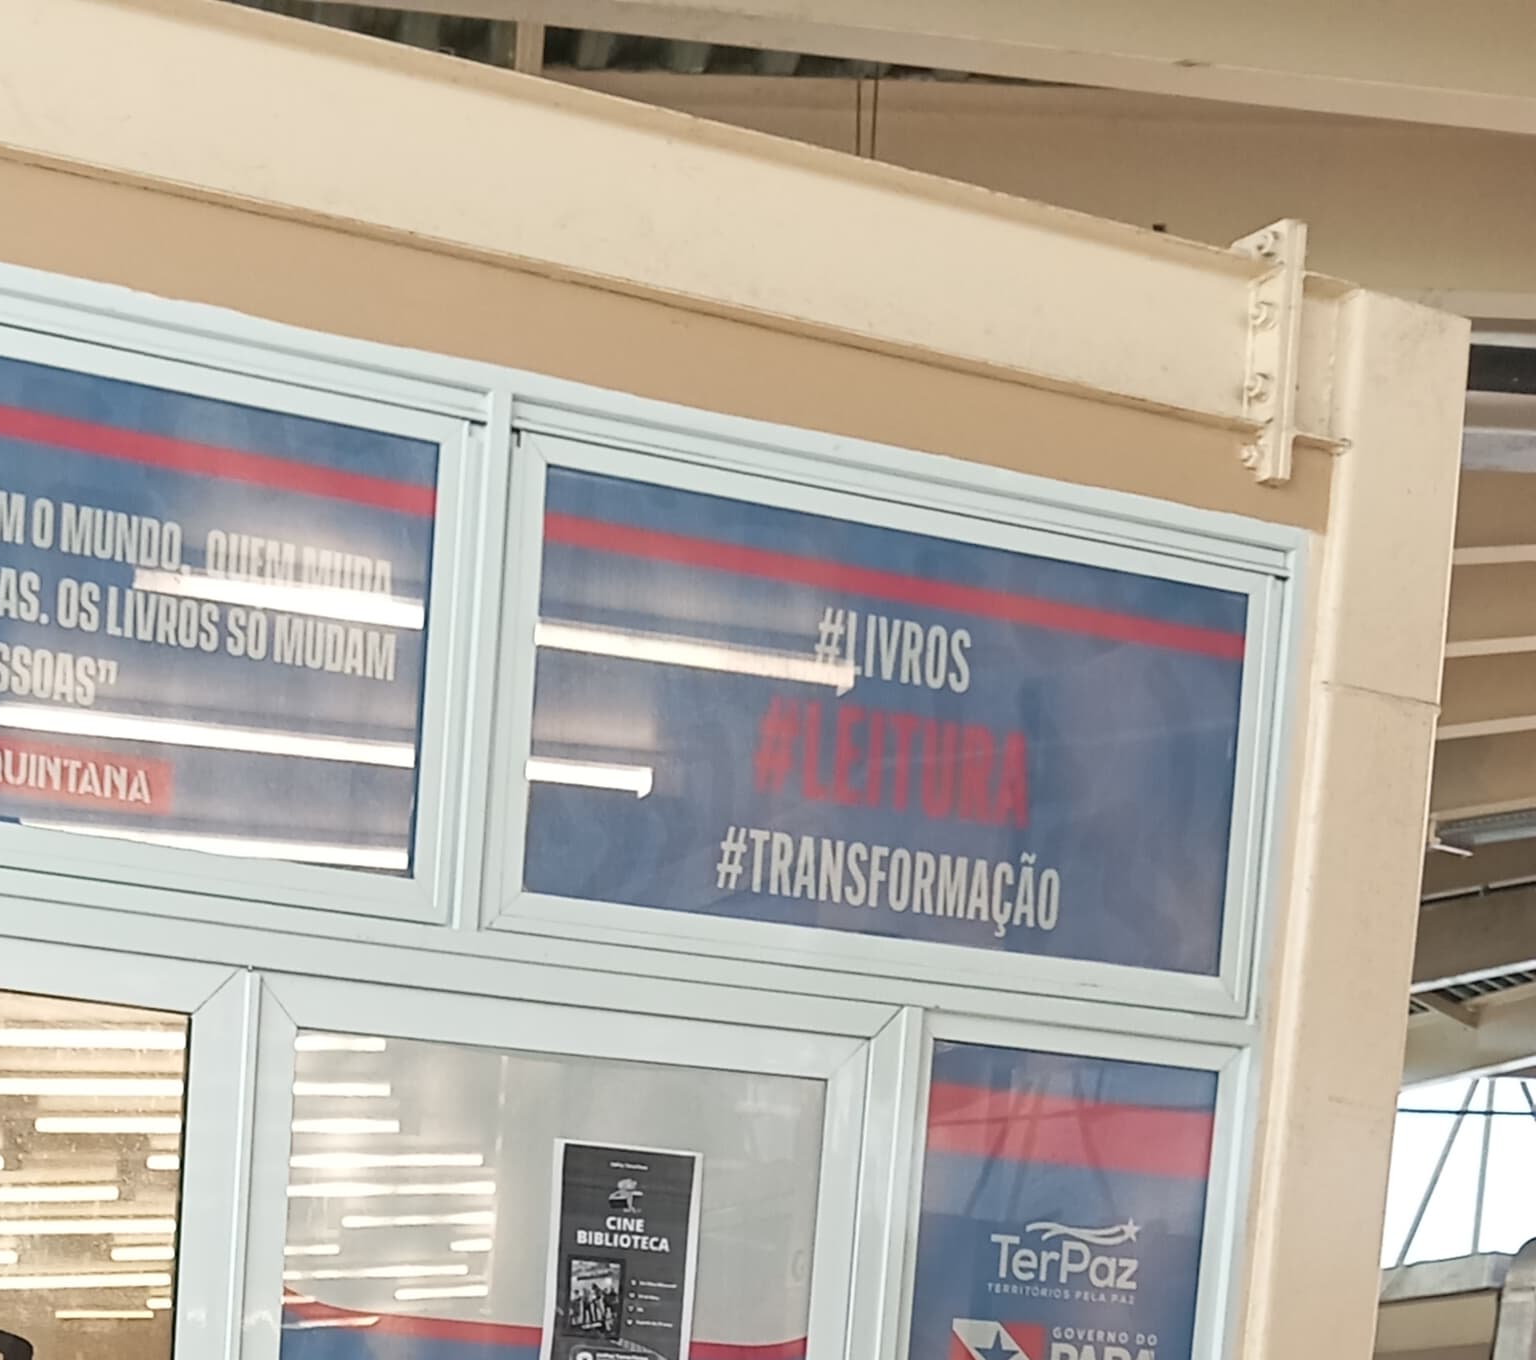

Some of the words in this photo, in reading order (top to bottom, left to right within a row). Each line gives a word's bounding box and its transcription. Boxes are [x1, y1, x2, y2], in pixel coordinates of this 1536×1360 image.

[32, 498, 54, 549] O
[58, 578, 100, 633] OS
[107, 585, 220, 652] LIVROS
[274, 614, 397, 681] MUDAM
[815, 607, 972, 693] #LIVROS
[753, 695, 1031, 829] #LEITURA
[717, 826, 1061, 937] #TRANSFORMAÇÃO
[576, 1230, 670, 1253] BIBLIOTECA
[605, 1216, 645, 1233] CINE
[990, 1233, 1139, 1290] TerPaz
[1052, 1326, 1128, 1344] GOVERNO
[1136, 1333, 1158, 1346] DO
